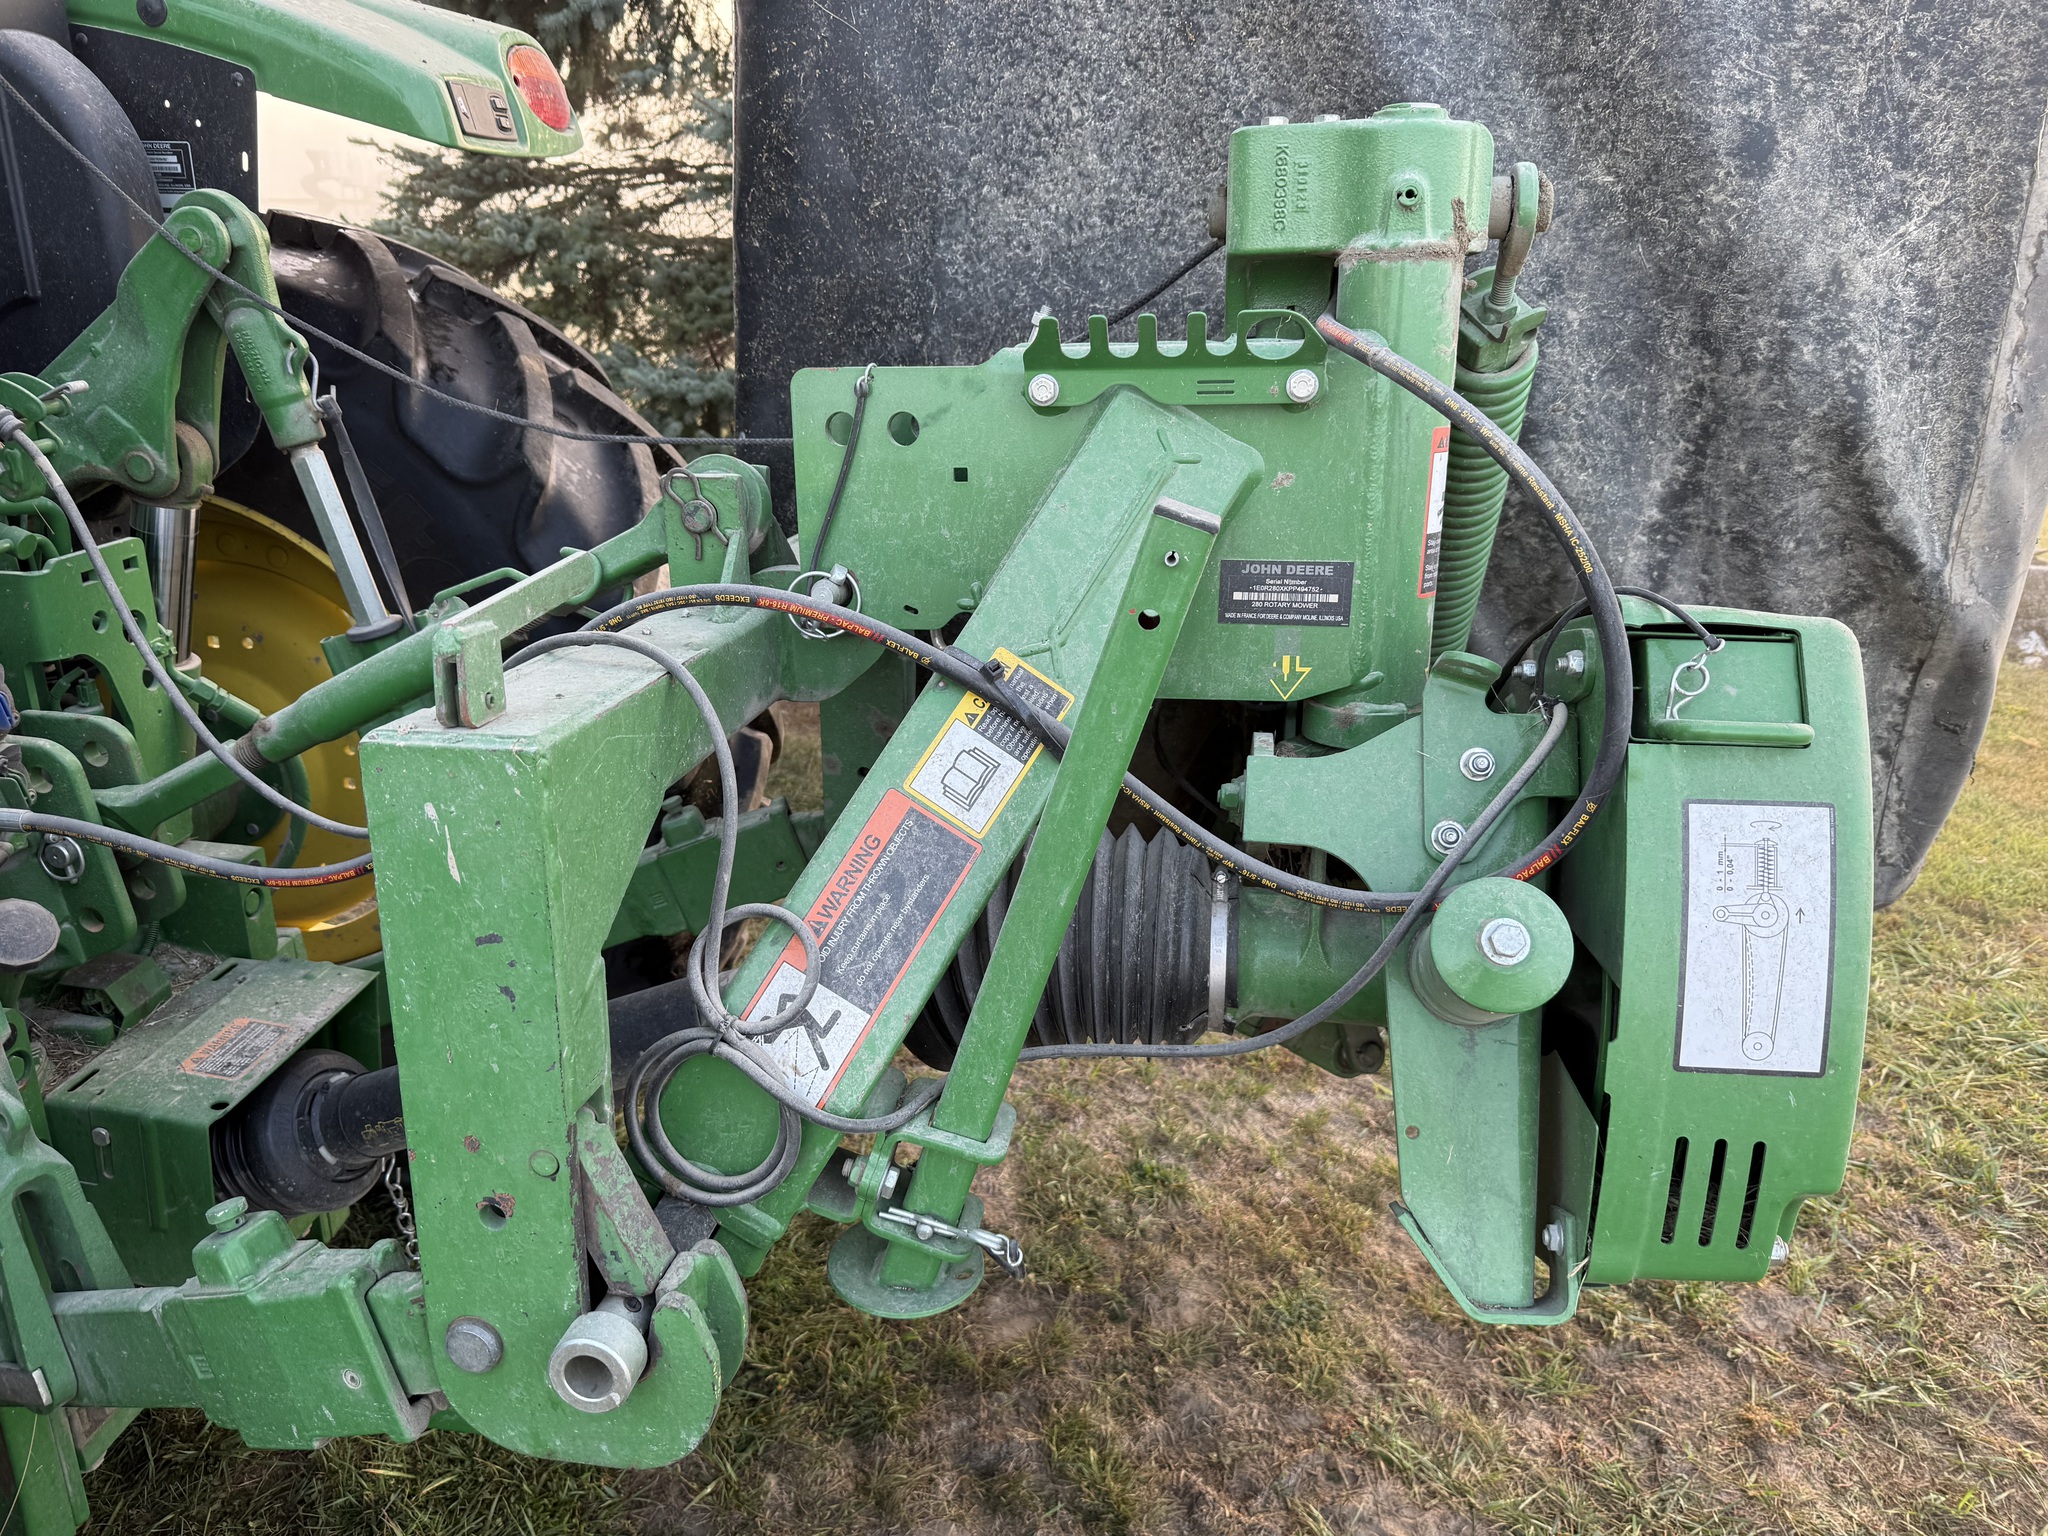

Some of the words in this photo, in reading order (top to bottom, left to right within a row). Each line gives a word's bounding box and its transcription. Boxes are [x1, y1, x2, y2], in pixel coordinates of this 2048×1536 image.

[1527, 475, 1555, 511] Resistant
[1554, 512, 1572, 538] MSHA
[1569, 536, 1594, 574] IC-252/00
[1241, 563, 1282, 575] JOHN
[1286, 564, 1334, 576] DEERE
[714, 594, 750, 602] EXCEEDS
[789, 603, 829, 621] PREMIUM
[834, 617, 871, 636] BALPAC
[884, 638, 919, 659] BALFLEX
[977, 714, 992, 732] Read
[984, 715, 1002, 738] before
[1012, 742, 1024, 757] and
[1043, 692, 1058, 710] when
[998, 730, 1014, 748] copy
[1005, 724, 1026, 752] Observe
[1130, 792, 1151, 810] MSHA
[1152, 808, 1182, 834] Resistant
[1560, 812, 1589, 847] BALFLEX
[1180, 830, 1201, 848] Flame
[1221, 858, 1234, 868] WP
[1718, 851, 1724, 866] mm
[328, 869, 355, 882] BALPAC
[815, 831, 883, 923] WARNING
[1515, 854, 1551, 883] BALPAC
[230, 874, 259, 884] EXCEEDS
[291, 877, 323, 886] PREMIUM
[826, 915, 852, 948] INJURY
[845, 889, 868, 918] FROM
[861, 854, 891, 892] THROWN
[884, 817, 915, 857] OBJECTS
[1260, 877, 1277, 888] DN8
[835, 951, 855, 976] Keep
[848, 921, 873, 954] curtains
[868, 913, 878, 924] in
[873, 890, 894, 916] place.
[853, 974, 865, 986] do
[859, 959, 875, 977] not
[869, 931, 895, 963] operate
[889, 912, 906, 933] near
